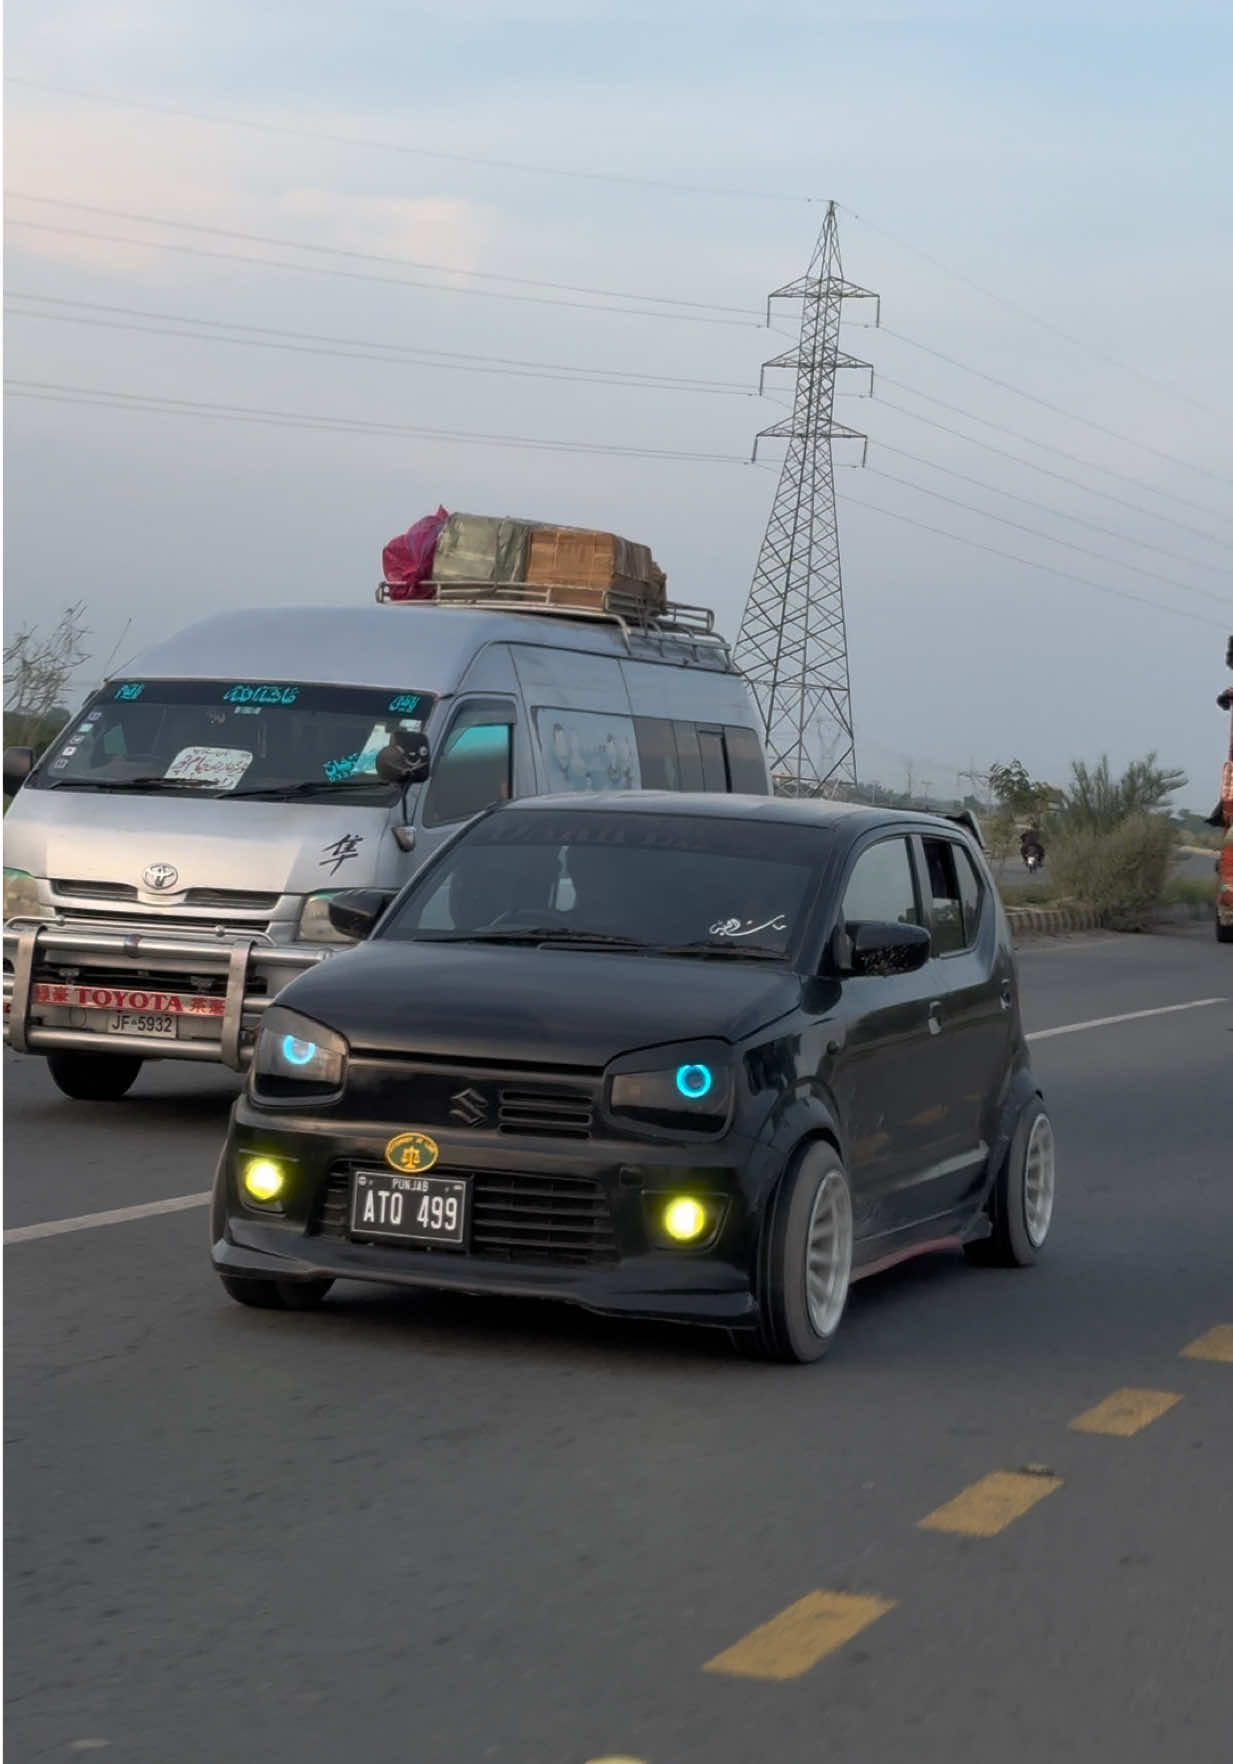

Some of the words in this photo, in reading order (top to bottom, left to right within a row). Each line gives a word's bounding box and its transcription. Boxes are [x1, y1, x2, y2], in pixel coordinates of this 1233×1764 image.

[75, 988, 184, 1012] TOYOTA
[392, 1178, 429, 1192] PUNJAB
[416, 1195, 458, 1231] 499
